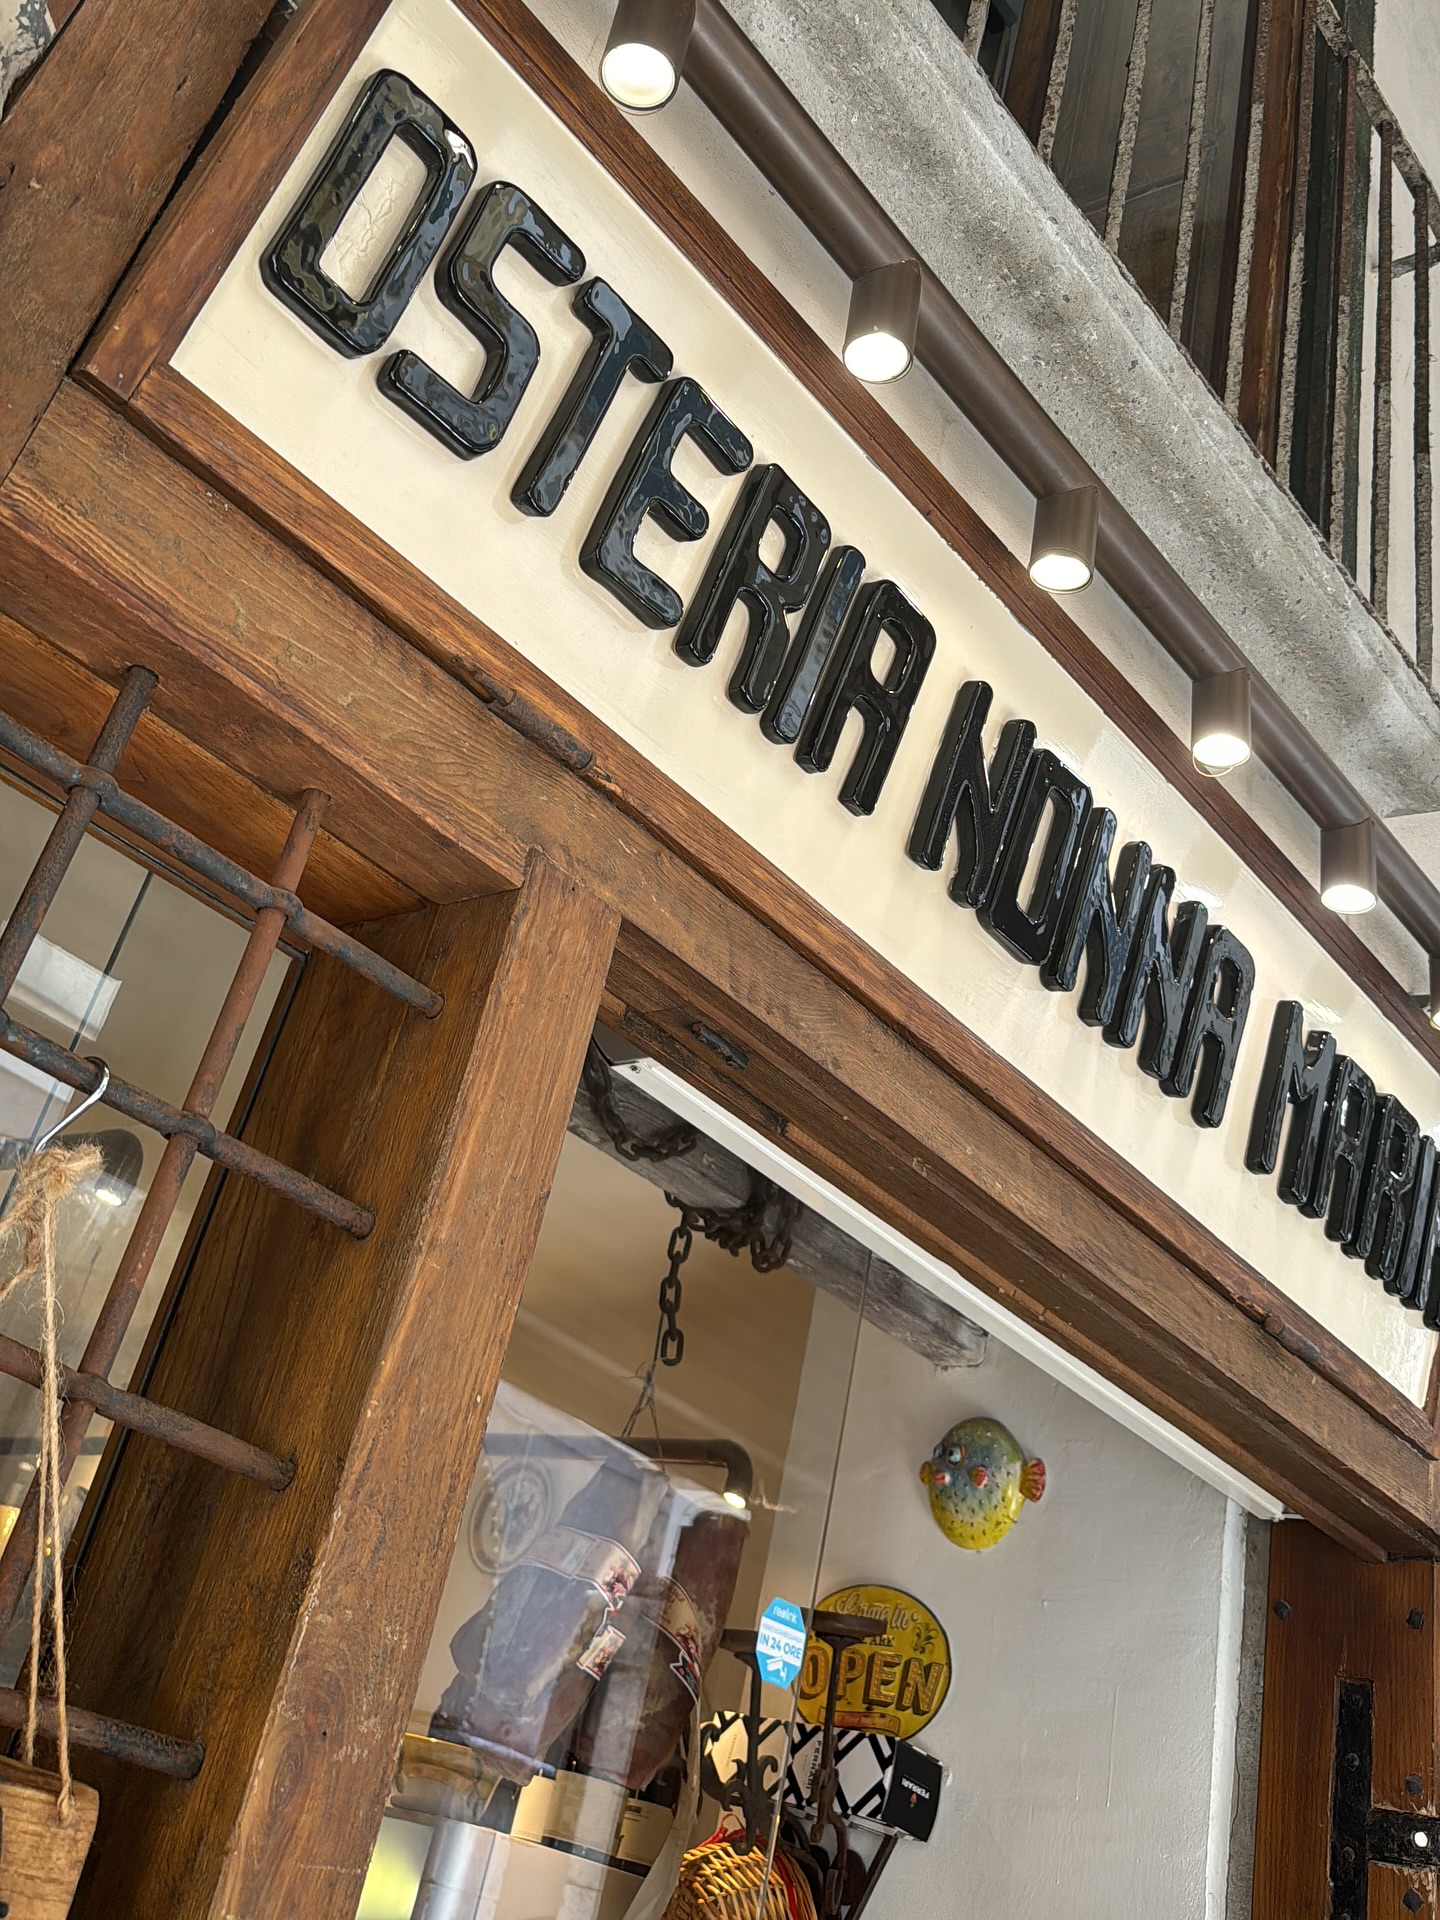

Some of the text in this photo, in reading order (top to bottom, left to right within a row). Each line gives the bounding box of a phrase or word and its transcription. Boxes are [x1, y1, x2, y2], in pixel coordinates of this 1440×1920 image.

[260, 68, 937, 817] OSTERIA
[906, 680, 1255, 1128] NONNA
[759, 1631, 770, 1647] IN
[770, 1637, 782, 1652] 24
[783, 1642, 803, 1660] ORE
[800, 1646, 944, 1716] OPEN
